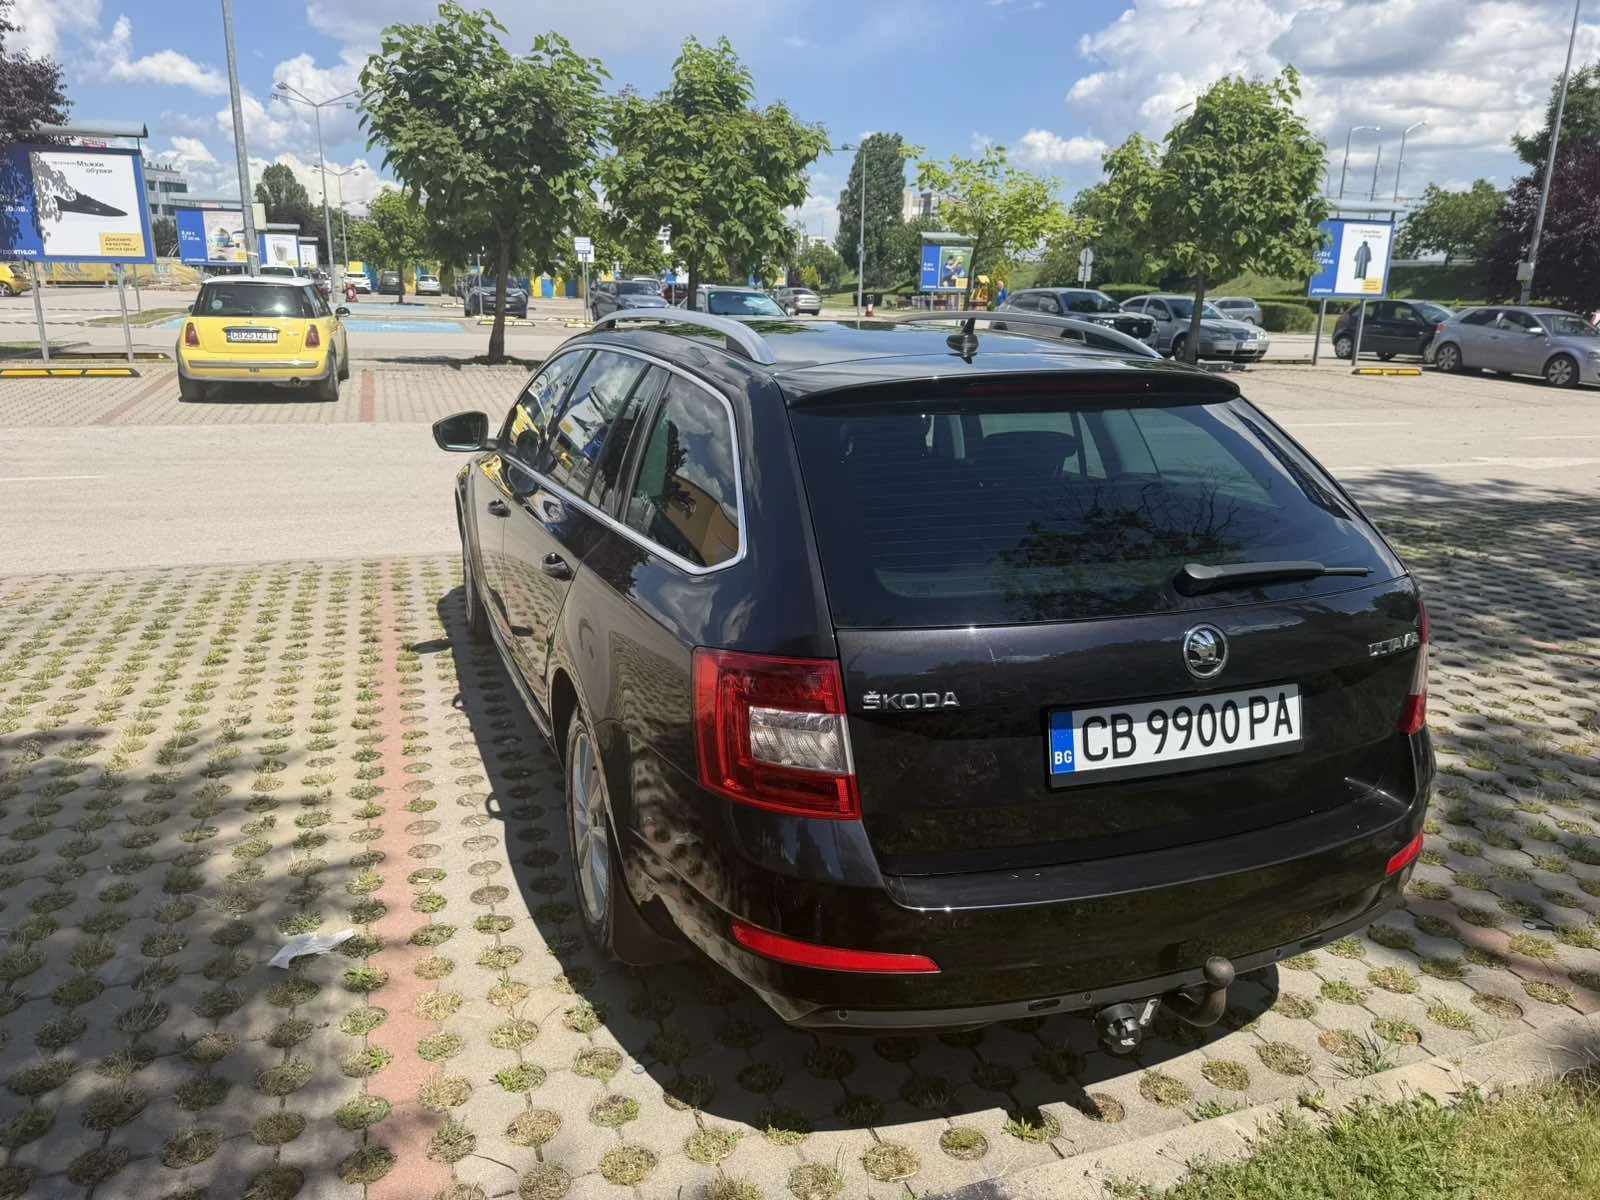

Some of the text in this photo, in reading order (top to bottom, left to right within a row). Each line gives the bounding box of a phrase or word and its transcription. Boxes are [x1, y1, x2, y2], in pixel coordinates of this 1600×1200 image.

[863, 690, 961, 710] ŠKODA
[1082, 692, 1293, 762] CB 9900 PA
[1054, 751, 1073, 765] BG
